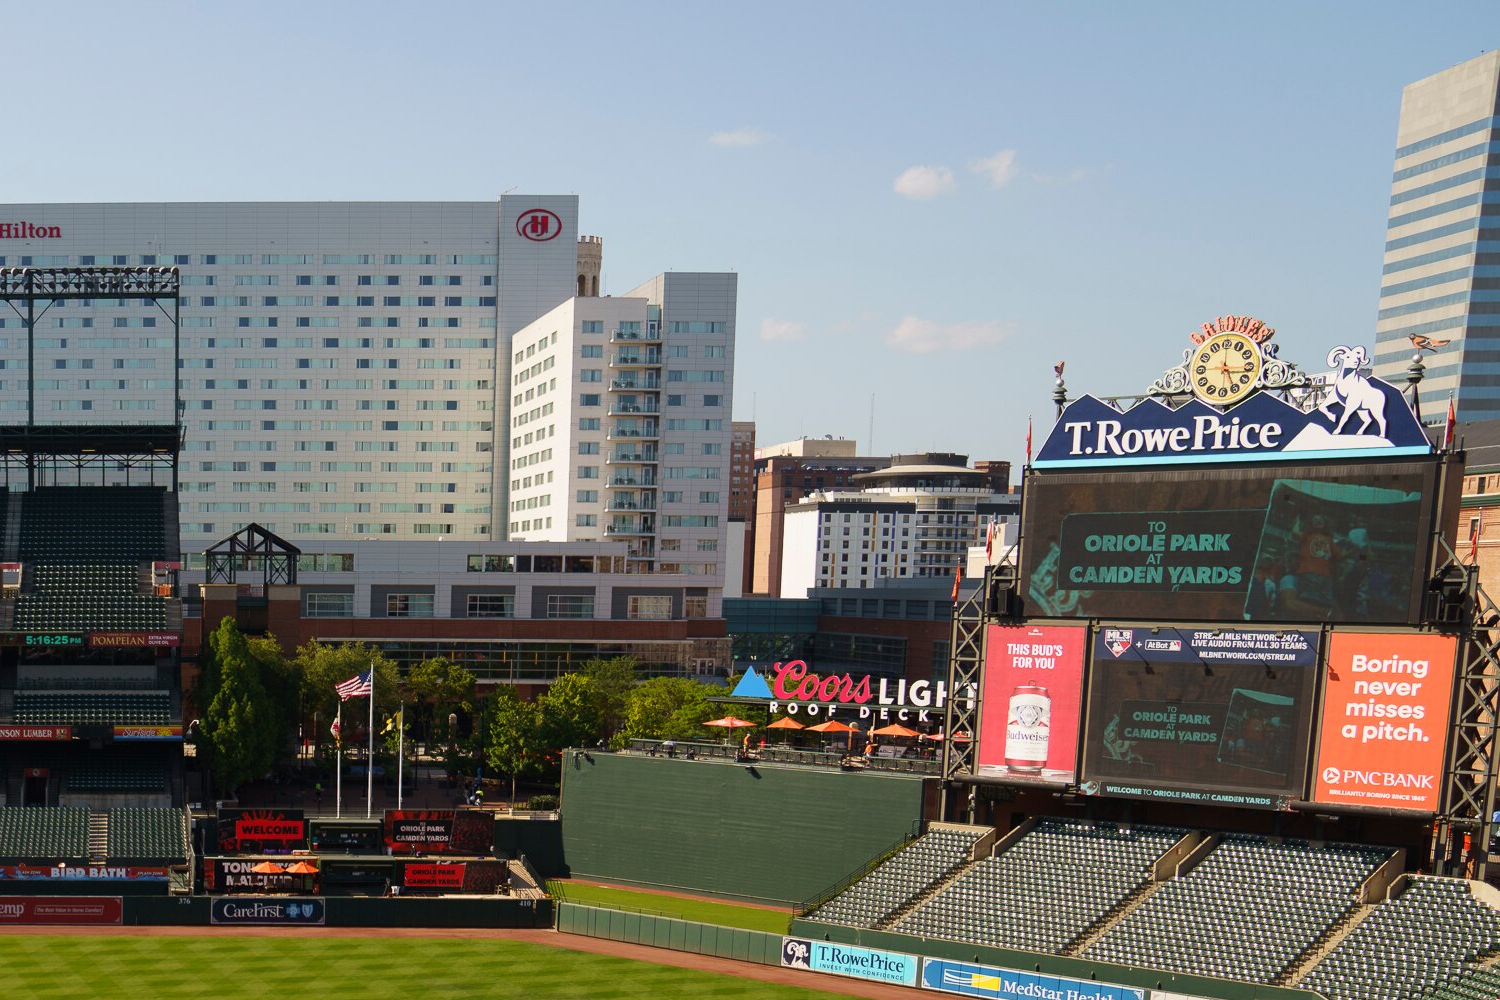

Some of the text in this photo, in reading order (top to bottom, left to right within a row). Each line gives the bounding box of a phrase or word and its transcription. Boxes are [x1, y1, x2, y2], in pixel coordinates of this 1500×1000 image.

[1189, 315, 1276, 346] ORIOLES
[1147, 521, 1166, 533] TO
[1084, 533, 1232, 552] ORIOLE PARK
[1146, 553, 1164, 565] AT
[1069, 566, 1243, 584] CAMDEN YARDS
[26, 635, 82, 645] 5:16:25 PM
[92, 636, 145, 645] POMPEIAN
[1107, 631, 1131, 639] MLB
[1193, 632, 1299, 643] STREAM MLB 24/7
[1007, 643, 1063, 657] THIS BUD'S
[1191, 640, 1208, 648] LIVE
[1232, 641, 1255, 649] FROM
[1255, 641, 1269, 649] ALL
[1269, 641, 1280, 649] 30
[1280, 642, 1308, 650] TEAMS
[1012, 656, 1055, 670] FOR YOU
[1199, 651, 1296, 661] MLBNETWORK.COM/STREAM
[1351, 654, 1429, 679] Boring
[773, 659, 874, 704] Coors
[1353, 680, 1422, 696] never
[769, 700, 929, 722] ROOF DECK
[1345, 698, 1425, 719] misses
[1132, 711, 1212, 726] ORIOLE PARK
[23, 729, 53, 738] LUMBER
[122, 727, 156, 737] Surfside
[1124, 727, 1217, 743] CAMDEN YARDS
[1341, 721, 1429, 743] a pitch.
[1106, 785, 1142, 795] WELCOME
[1143, 788, 1153, 796] TO
[1153, 789, 1180, 798] ORIOLE
[1181, 790, 1201, 799] PARK
[1211, 794, 1245, 803] CAMDEN
[1246, 796, 1271, 805] YARDS
[1329, 789, 1366, 798] BRILLIANTLY
[1366, 791, 1391, 799] BORING
[1391, 793, 1411, 801] SINCE
[241, 825, 299, 835] WELCOME
[50, 867, 126, 879] BIRD BATH
[223, 903, 284, 919] CareFirst
[519, 900, 533, 908] 410
[819, 963, 905, 981] INVEST WITH CONFIDENCE
[1003, 980, 1064, 1000] MedStar
